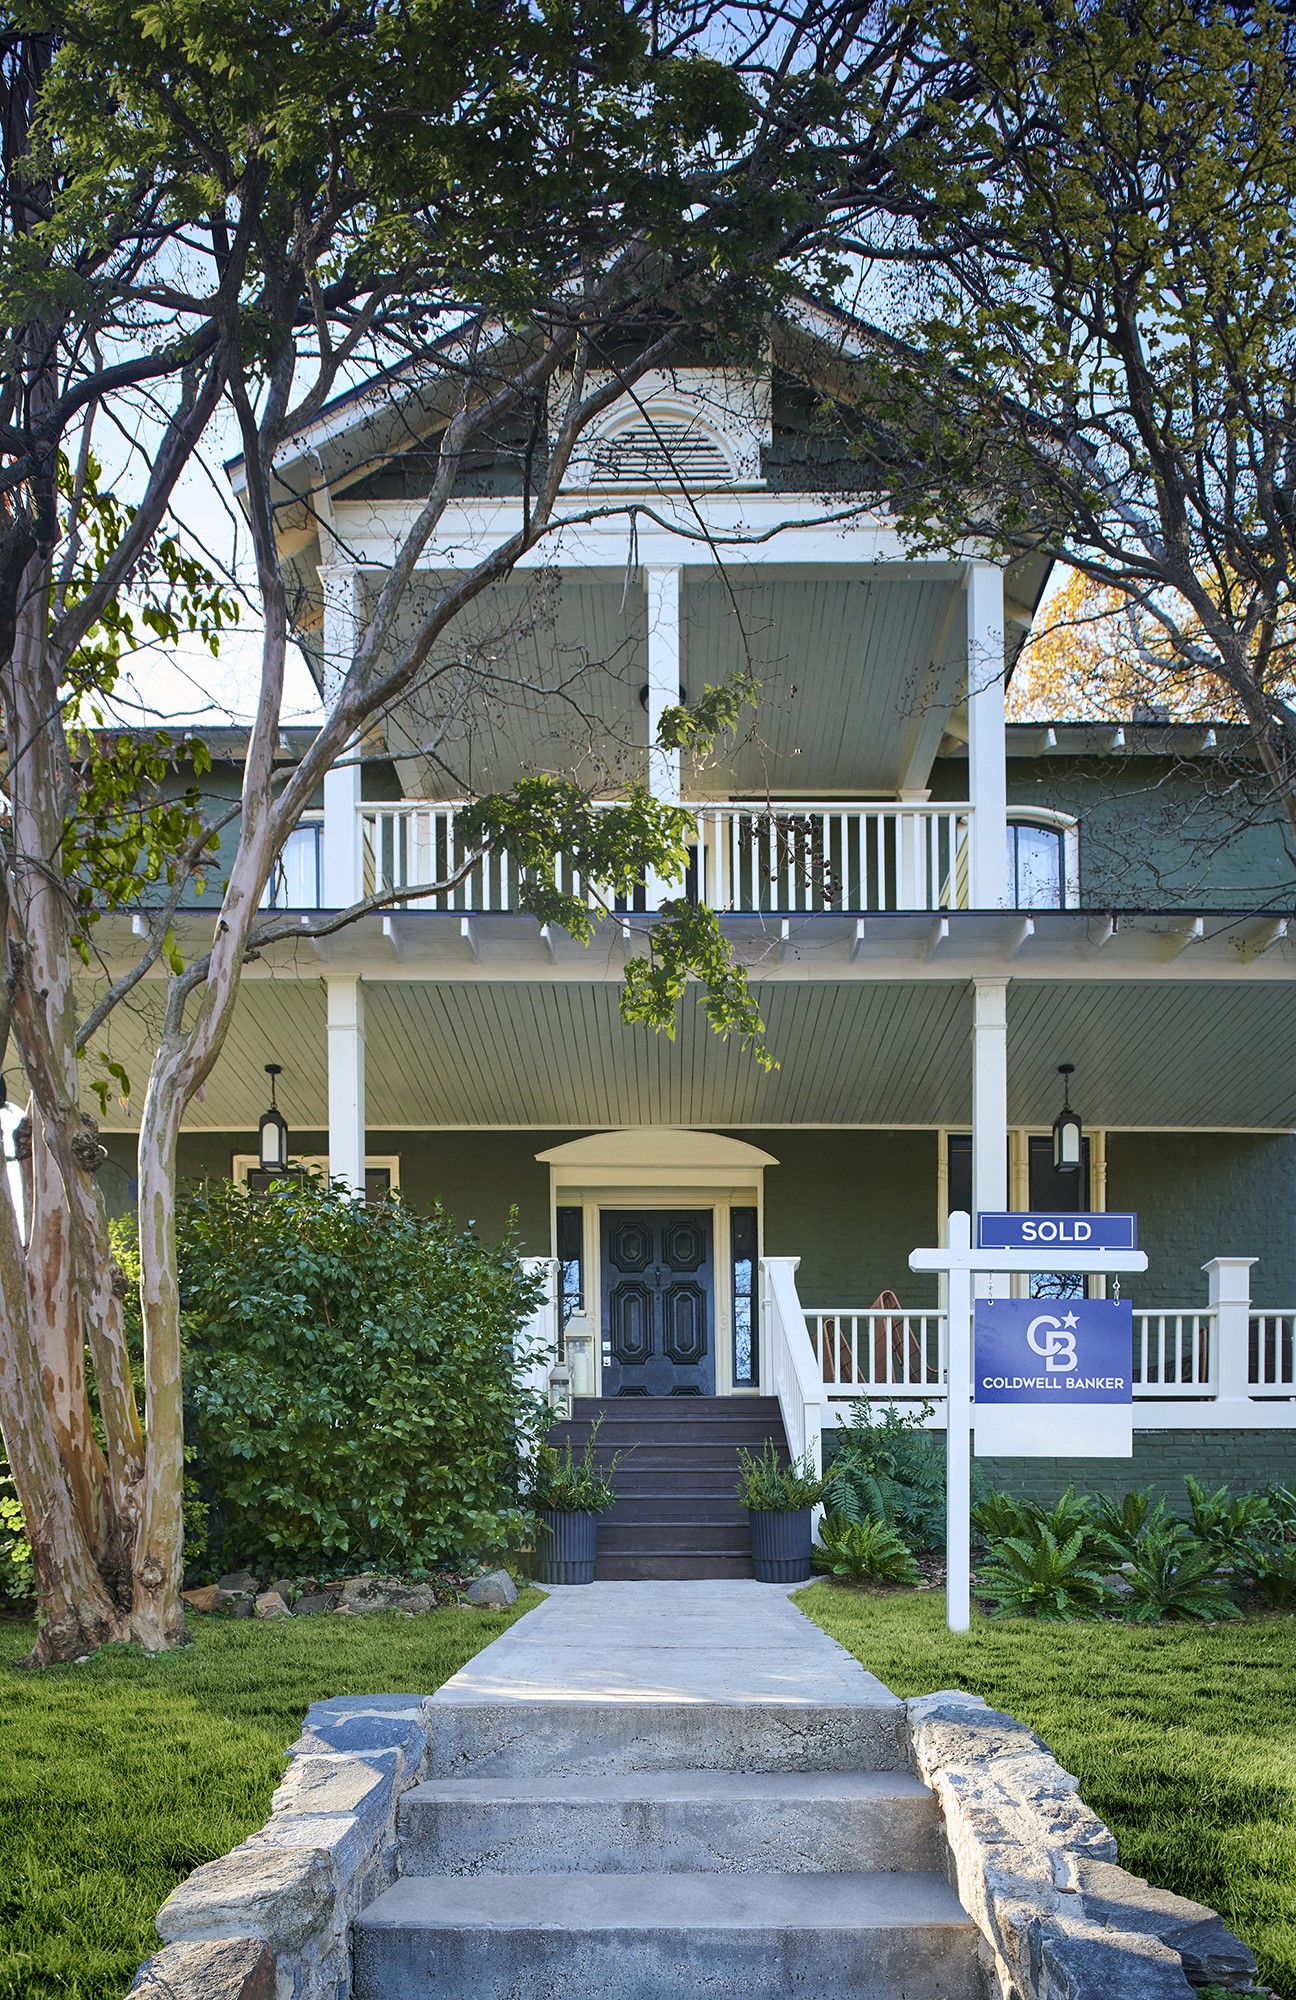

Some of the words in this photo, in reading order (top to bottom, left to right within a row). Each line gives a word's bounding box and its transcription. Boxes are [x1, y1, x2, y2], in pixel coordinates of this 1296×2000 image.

[1021, 1221, 1092, 1241] SOLD
[1026, 1315, 1078, 1372] CB
[982, 1377, 1062, 1389] COLDWELL
[1065, 1377, 1124, 1389] BANKER
